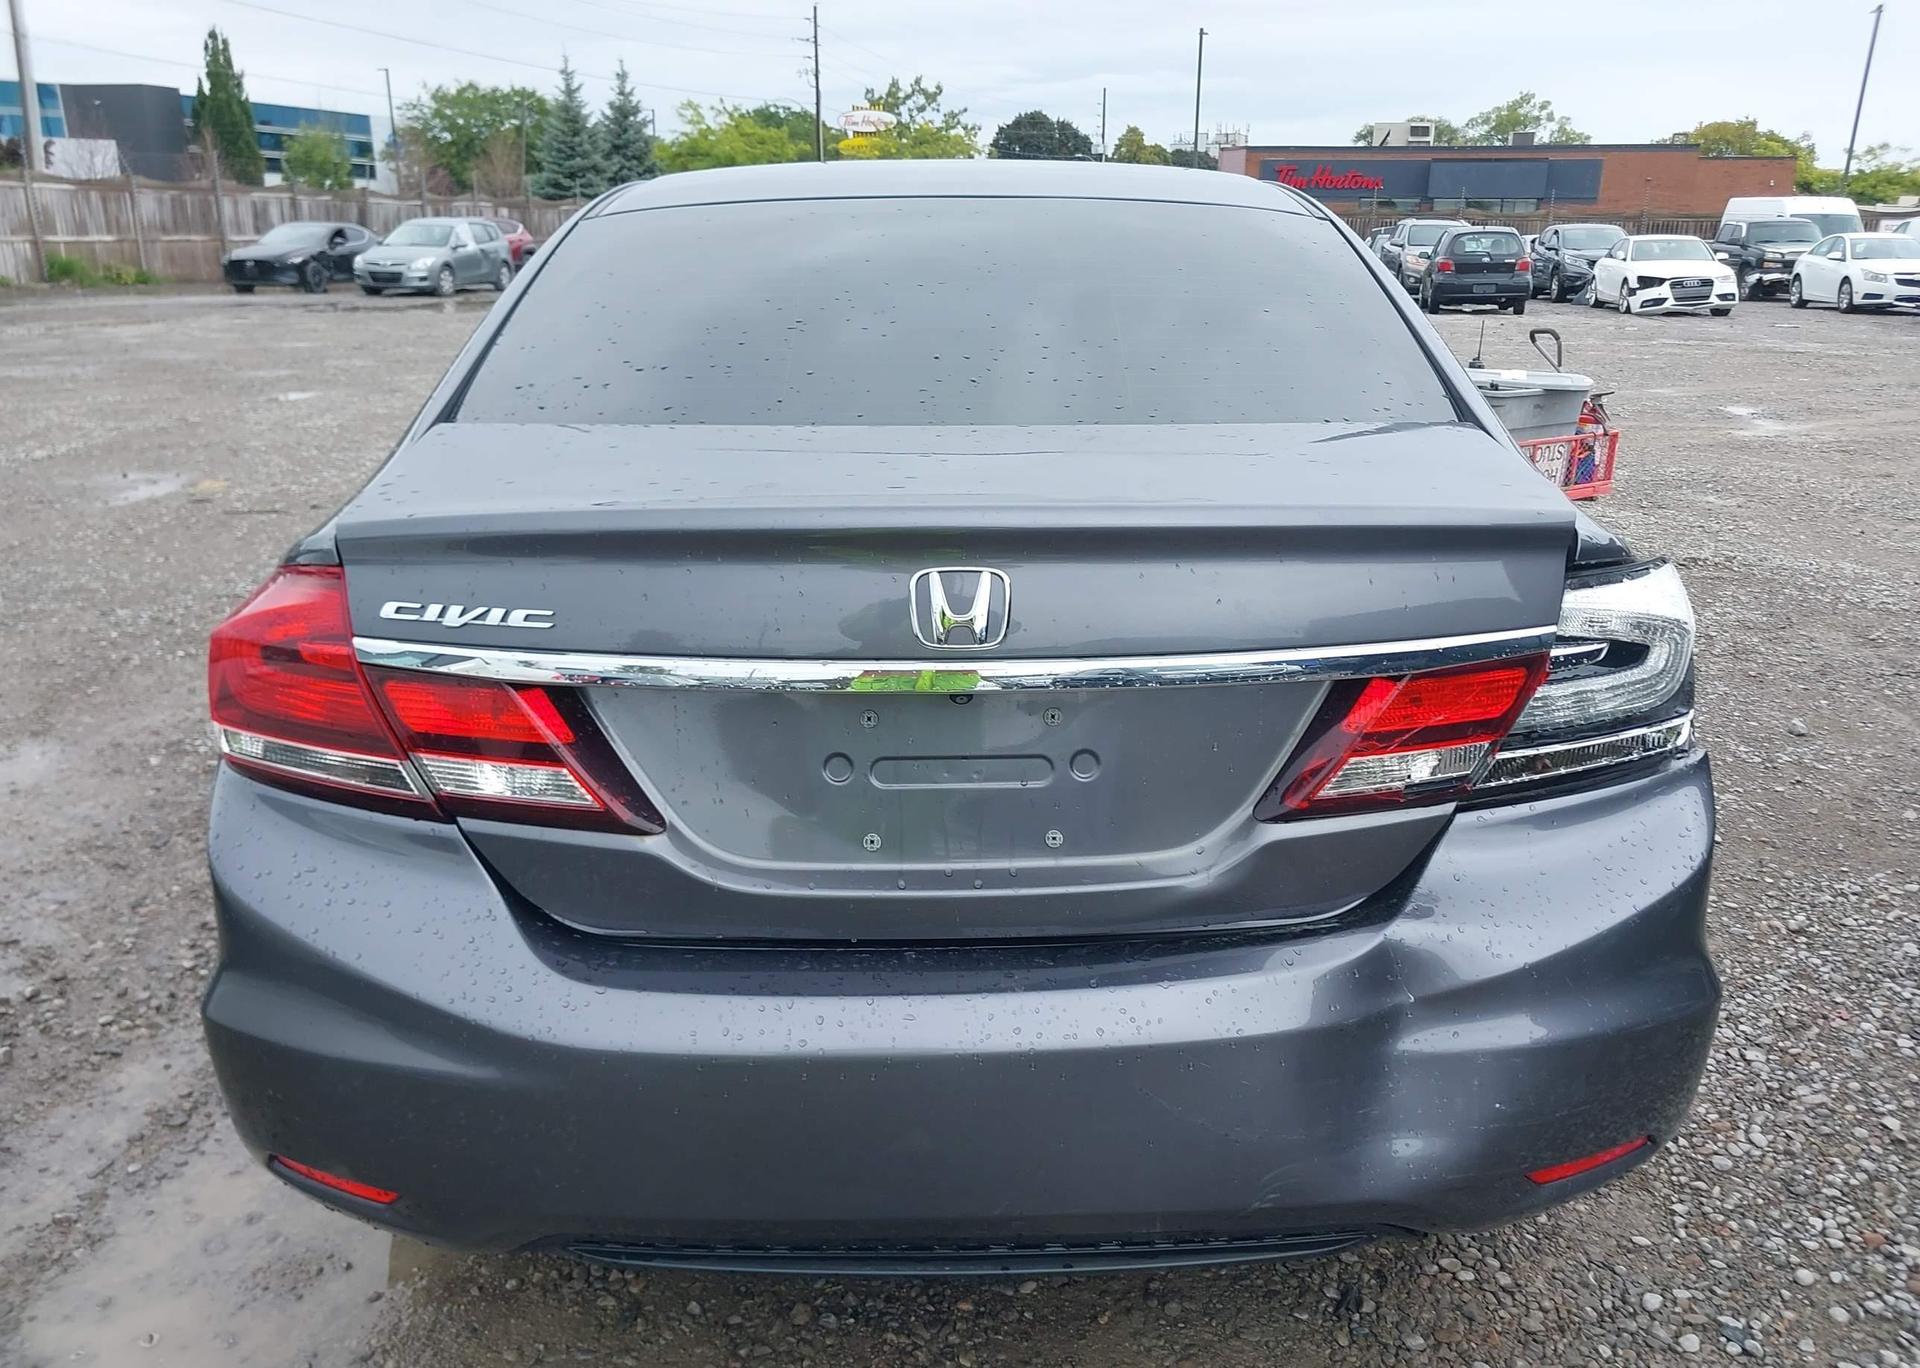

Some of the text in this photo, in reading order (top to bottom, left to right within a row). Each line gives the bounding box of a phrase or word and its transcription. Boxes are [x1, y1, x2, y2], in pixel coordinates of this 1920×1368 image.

[1274, 163, 1384, 190] Tim Hortons
[379, 601, 556, 628] CIVIC
